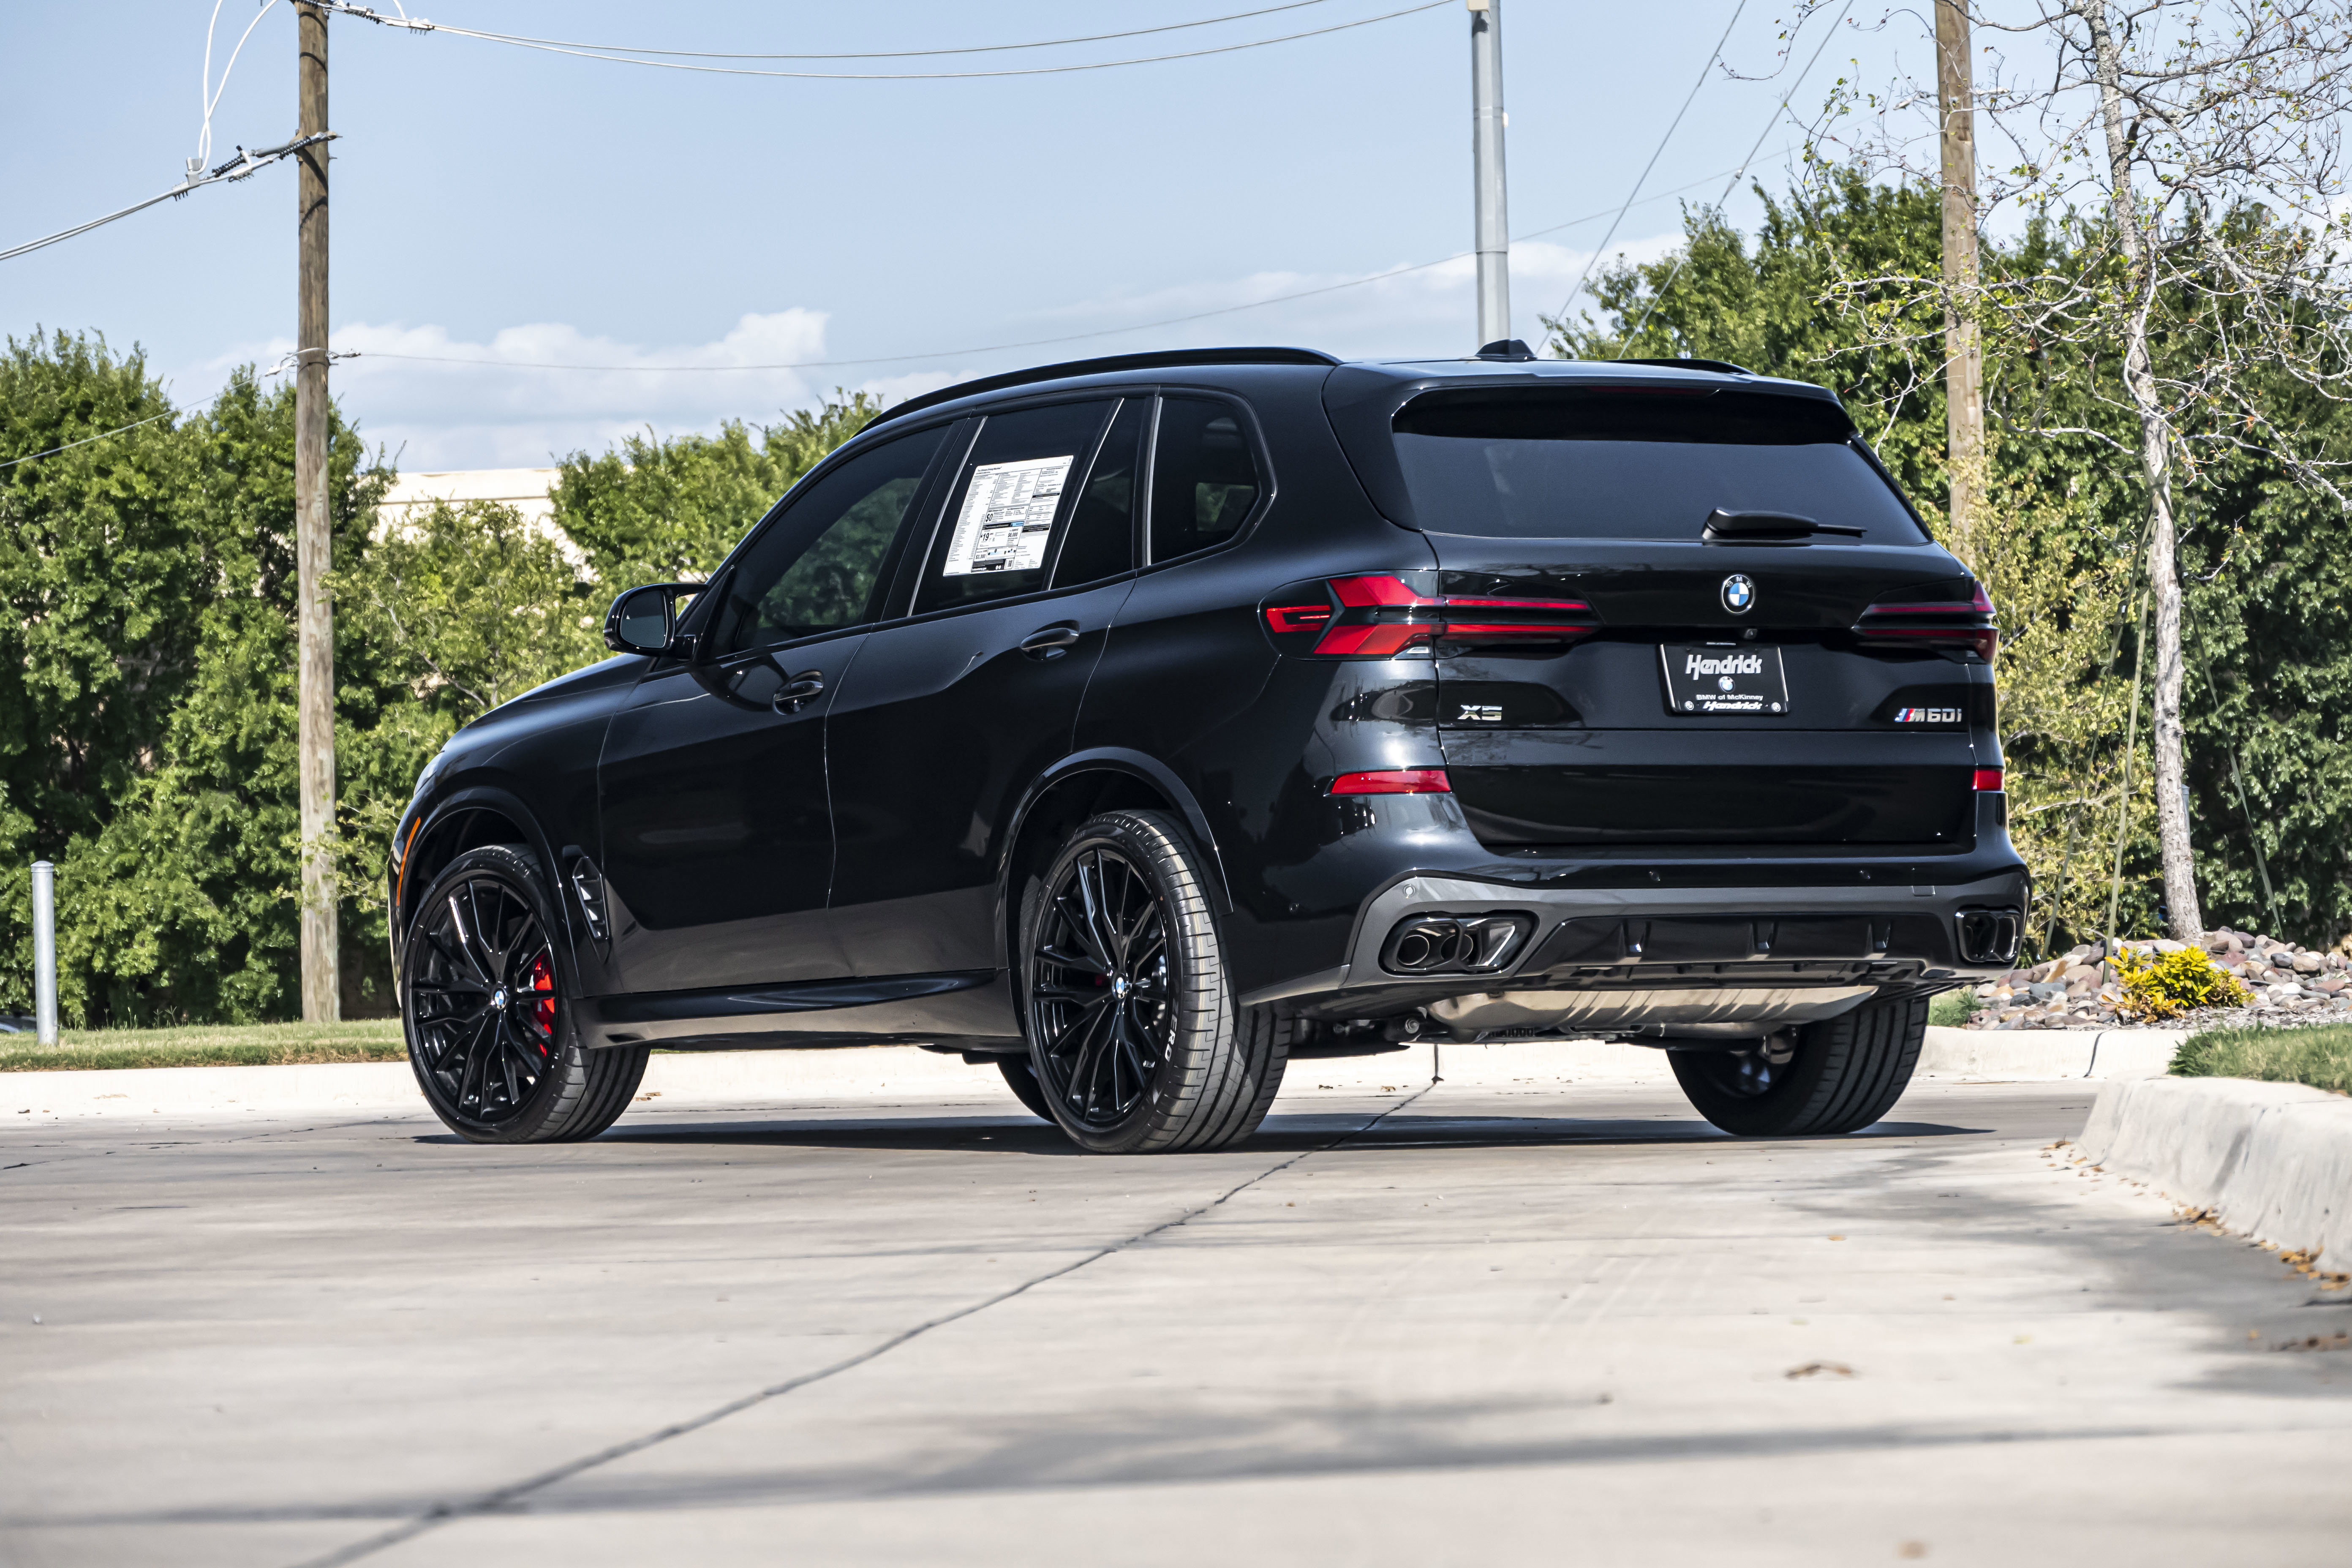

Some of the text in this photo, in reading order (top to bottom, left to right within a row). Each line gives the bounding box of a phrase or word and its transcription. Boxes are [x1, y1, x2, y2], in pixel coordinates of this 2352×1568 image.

[983, 533, 990, 541] 19
[1726, 576, 1752, 588] BMW
[1685, 654, 1762, 680] Hendrick
[1702, 701, 1763, 711] Hendrick
[1457, 705, 1502, 721] X5
[1909, 708, 1962, 722] M60i
